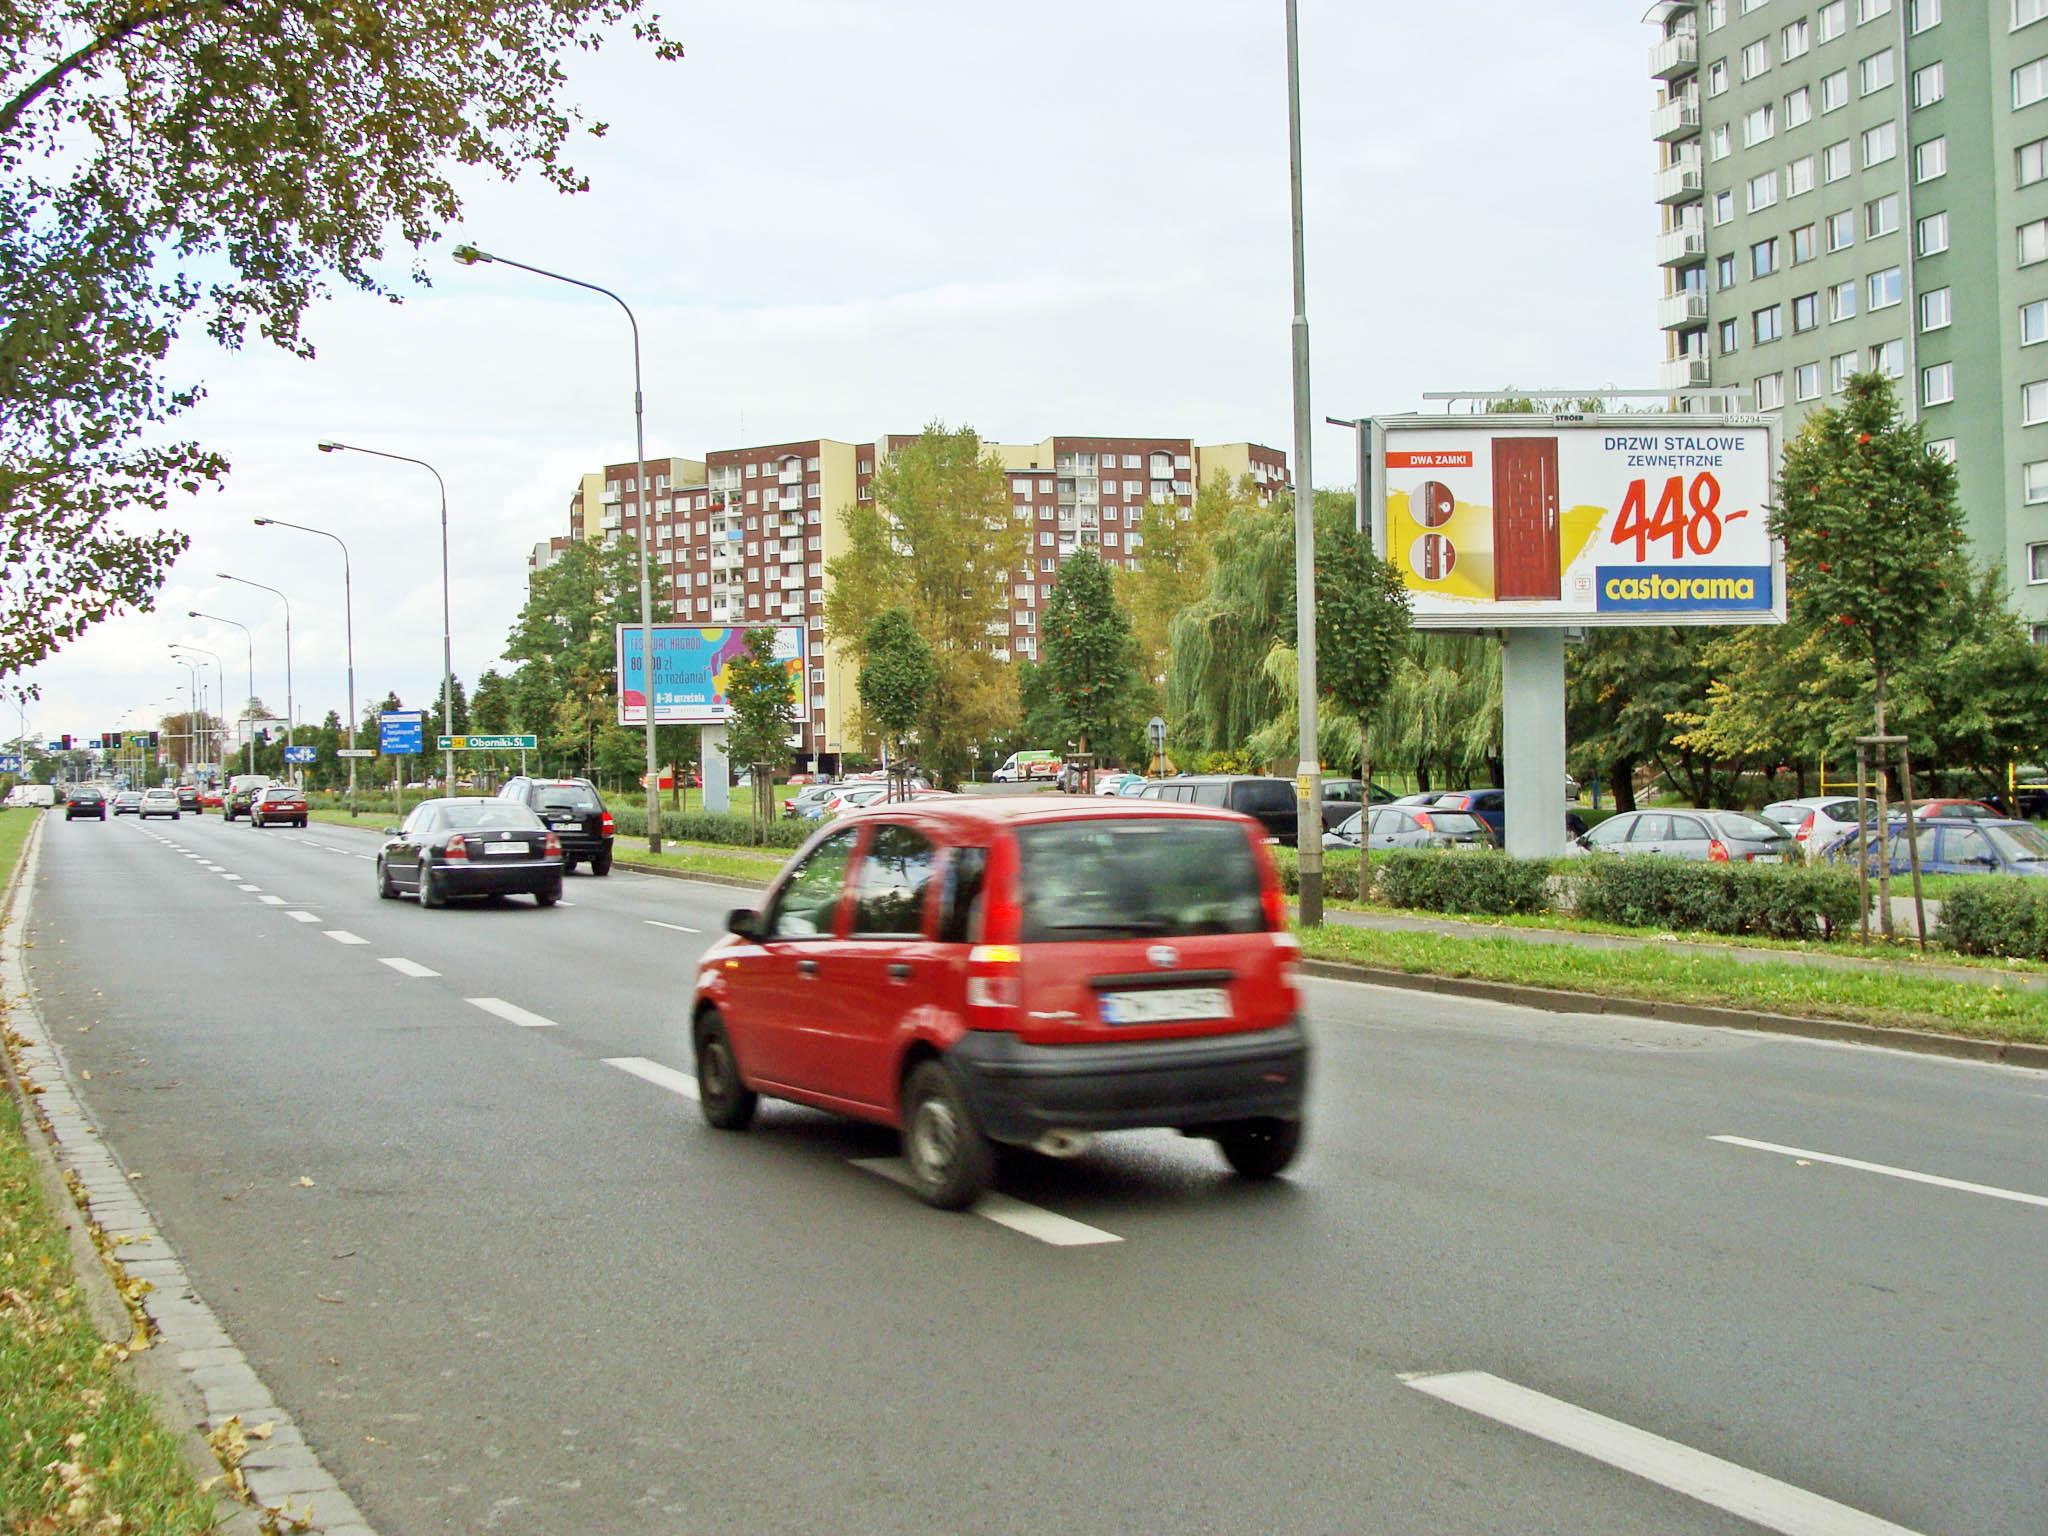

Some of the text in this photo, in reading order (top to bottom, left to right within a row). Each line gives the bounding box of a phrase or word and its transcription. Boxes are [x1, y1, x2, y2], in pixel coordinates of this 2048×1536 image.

[1604, 437, 1745, 451] DRZWI STALOWE
[1410, 455, 1466, 465] DWA ZAMKI
[1627, 454, 1723, 469] ZEWNĘTRZNE
[1605, 573, 1754, 600] castorama
